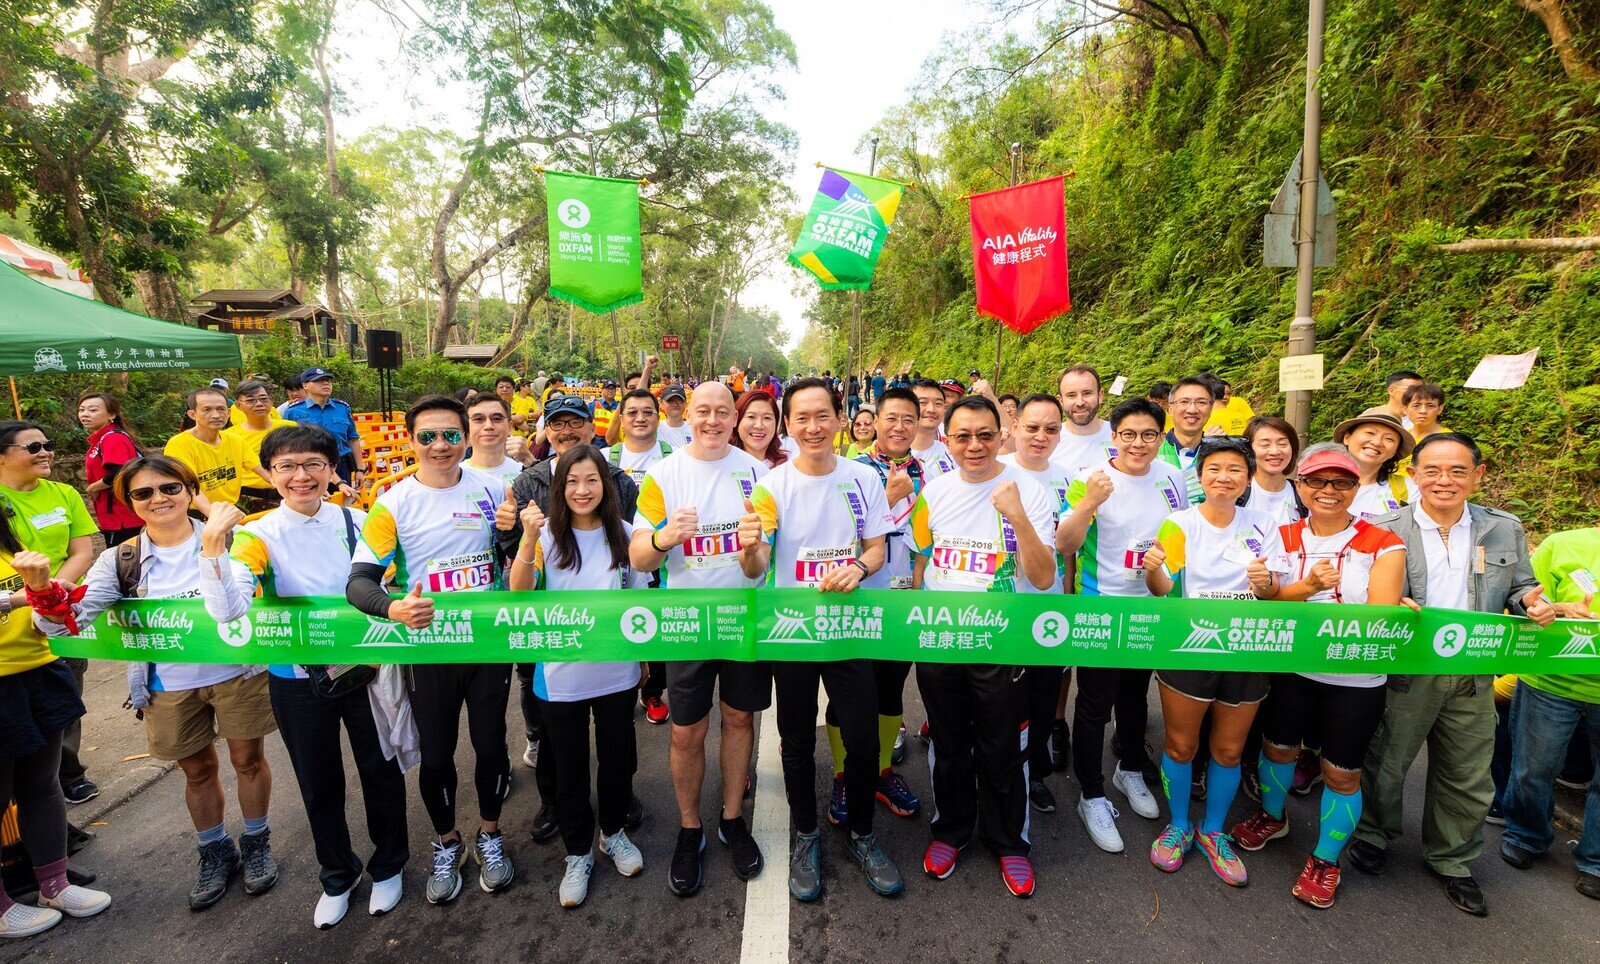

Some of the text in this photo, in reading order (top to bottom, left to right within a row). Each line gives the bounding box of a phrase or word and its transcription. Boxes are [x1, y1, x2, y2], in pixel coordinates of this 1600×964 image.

[559, 231, 592, 243] 樂施會
[812, 223, 873, 253] OXFAM
[983, 226, 1057, 249] AIA Vitality
[559, 244, 593, 254] OXFAM
[810, 233, 870, 259] TRAILWALKER
[608, 257, 630, 265] Poverty
[993, 244, 1046, 265] 健康程式
[78, 347, 184, 359] 香港少年領袖團
[77, 361, 102, 371] Hong
[104, 360, 127, 370] Kong
[168, 360, 190, 369] Corps
[691, 532, 738, 557] L011
[971, 541, 992, 550] 2018
[472, 553, 489, 563] 2018
[939, 549, 988, 573] L015
[438, 565, 490, 592] L005
[256, 610, 292, 624] 樂施會
[433, 609, 472, 620] 毅行者
[660, 606, 699, 619] 樂施會
[815, 605, 884, 617] 樂施毅行者
[107, 607, 193, 634] AIA Vitality
[494, 604, 596, 632] AIA Vitality
[814, 616, 883, 631] OXFAM
[906, 604, 1009, 634] AIA Vitality
[1074, 612, 1113, 626] 樂施會
[1230, 617, 1297, 630] 樂施毅行者
[256, 626, 292, 637] OXFAM
[661, 622, 700, 633] OXFAM
[1072, 628, 1112, 640] OXFAM
[1316, 618, 1414, 645] AIA Vitality
[1471, 623, 1506, 636] 樂施會
[121, 632, 184, 650] 健康程式
[508, 630, 582, 649] 健康程式
[662, 635, 697, 643] Hong Kong
[718, 634, 744, 642] Poverty
[815, 631, 882, 640] TRAILWALKER
[918, 630, 992, 650] 健康程式
[1228, 629, 1294, 644] OXFAM
[257, 639, 274, 647] Hong
[1072, 640, 1107, 650] Hong Kong
[1127, 642, 1153, 651] Poverty
[1228, 643, 1293, 652] TRAILWALKER
[1467, 638, 1503, 648] OXFAM
[1326, 642, 1397, 661] 健康程式
